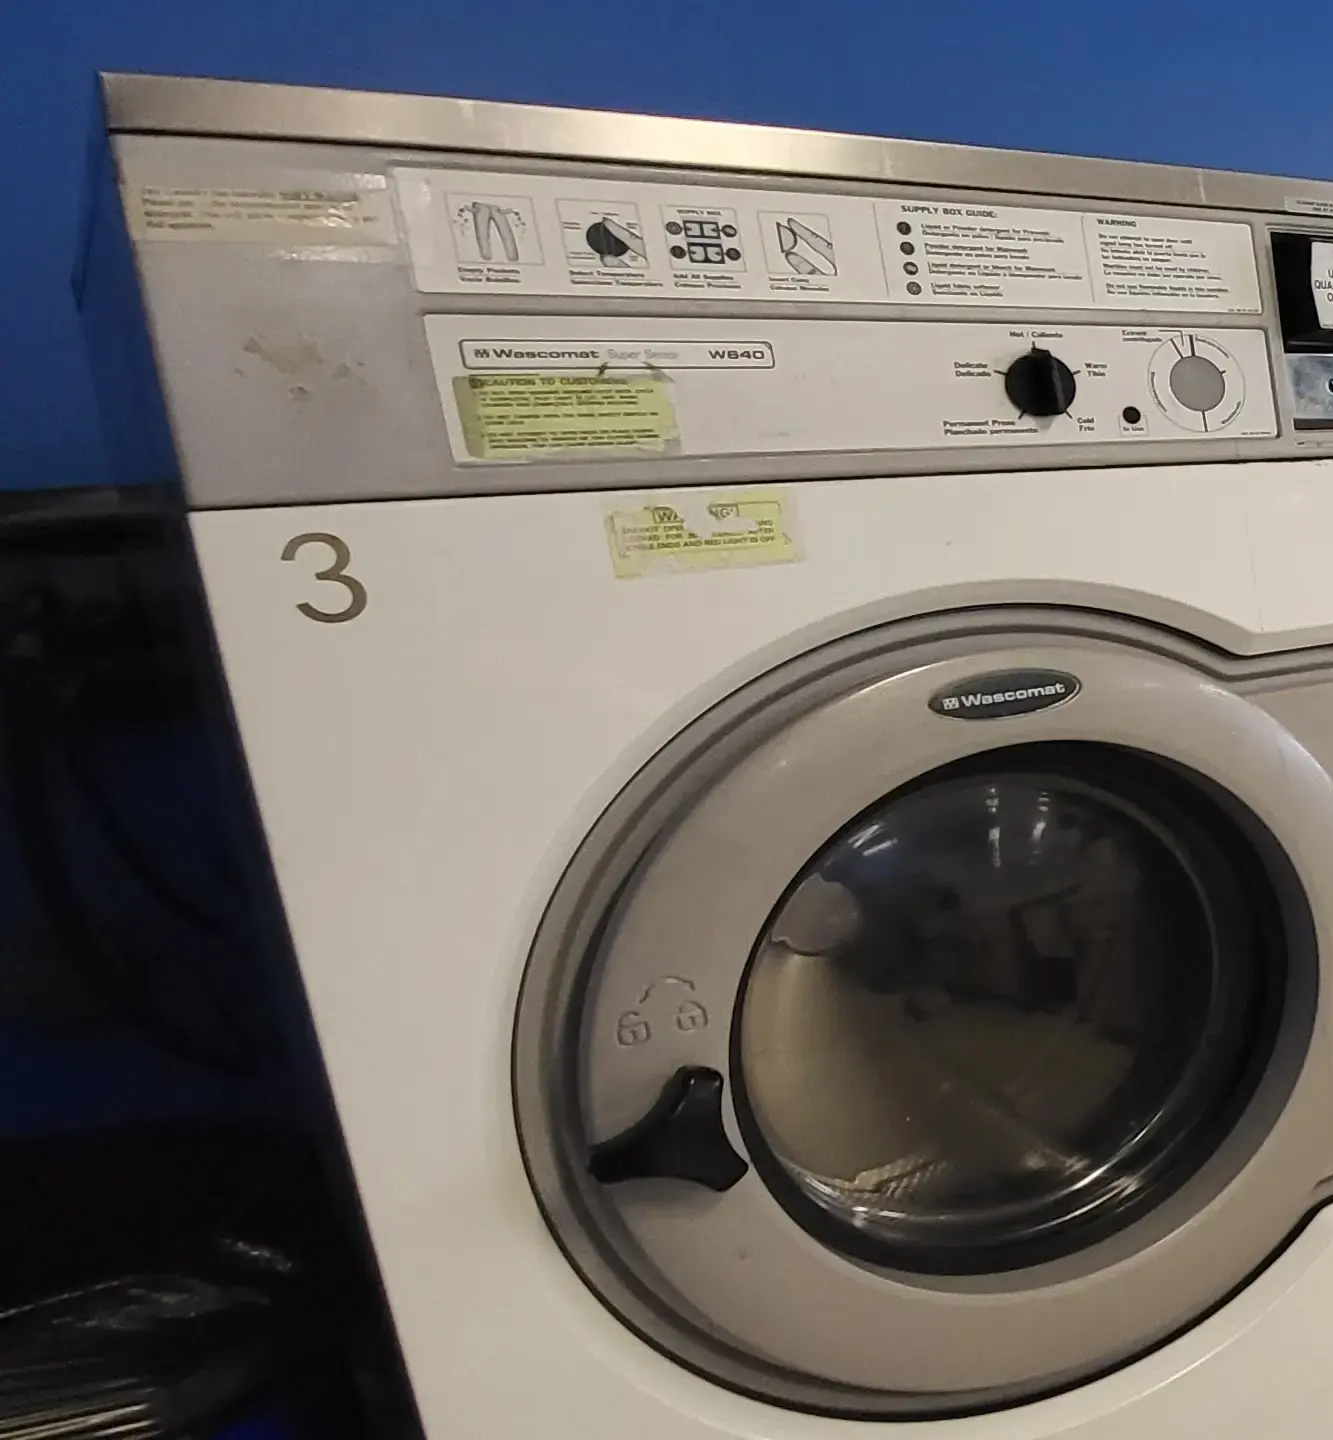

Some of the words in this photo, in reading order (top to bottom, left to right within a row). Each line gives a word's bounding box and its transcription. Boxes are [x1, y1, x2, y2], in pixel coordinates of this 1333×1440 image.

[901, 205, 938, 215] SUPPLY
[942, 207, 963, 216] BOX
[1096, 218, 1137, 228] WARNING
[493, 348, 600, 360] Wascomat
[708, 350, 766, 360] W640
[281, 532, 368, 623] 3
[960, 682, 1066, 708] Wascomat
